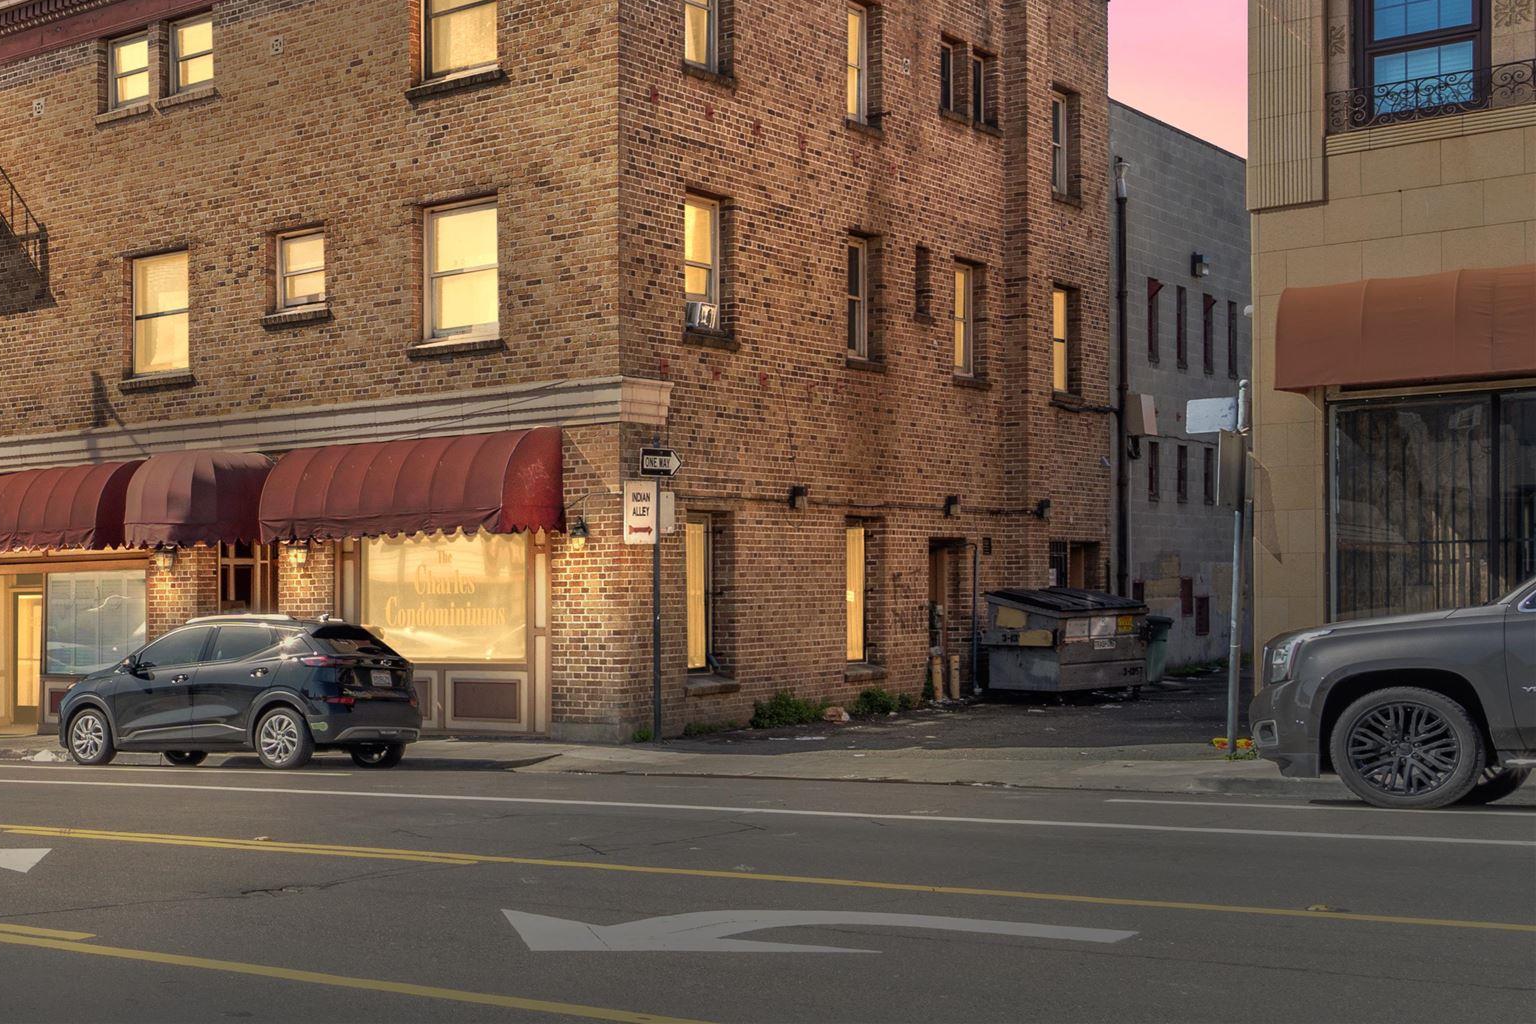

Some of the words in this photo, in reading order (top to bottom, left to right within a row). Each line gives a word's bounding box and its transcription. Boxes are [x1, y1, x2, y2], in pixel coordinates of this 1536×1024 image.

[645, 457, 657, 467] ONE
[659, 457, 671, 468] WAY
[631, 492, 651, 503] INDIAN
[632, 507, 650, 517] ALLEY
[438, 550, 453, 564] The
[415, 564, 476, 595] Charles
[385, 595, 506, 627] Condominiums
